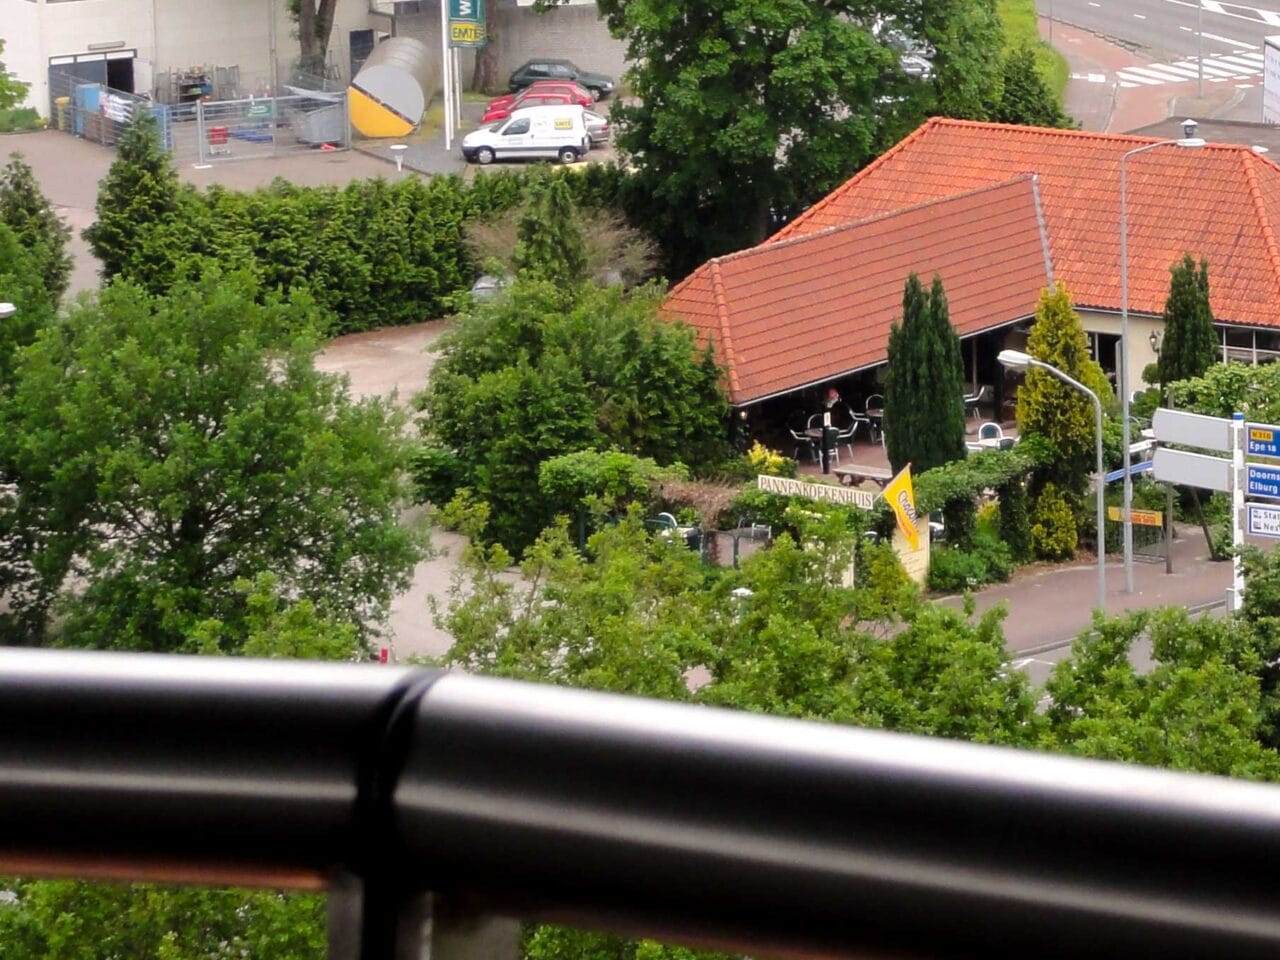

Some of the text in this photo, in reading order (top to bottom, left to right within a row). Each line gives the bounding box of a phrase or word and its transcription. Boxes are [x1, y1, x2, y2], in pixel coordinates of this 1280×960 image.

[1250, 442, 1265, 452] Epe
[761, 477, 872, 506] PANNENKOEKENHUIS
[1250, 481, 1278, 494] Elburg
